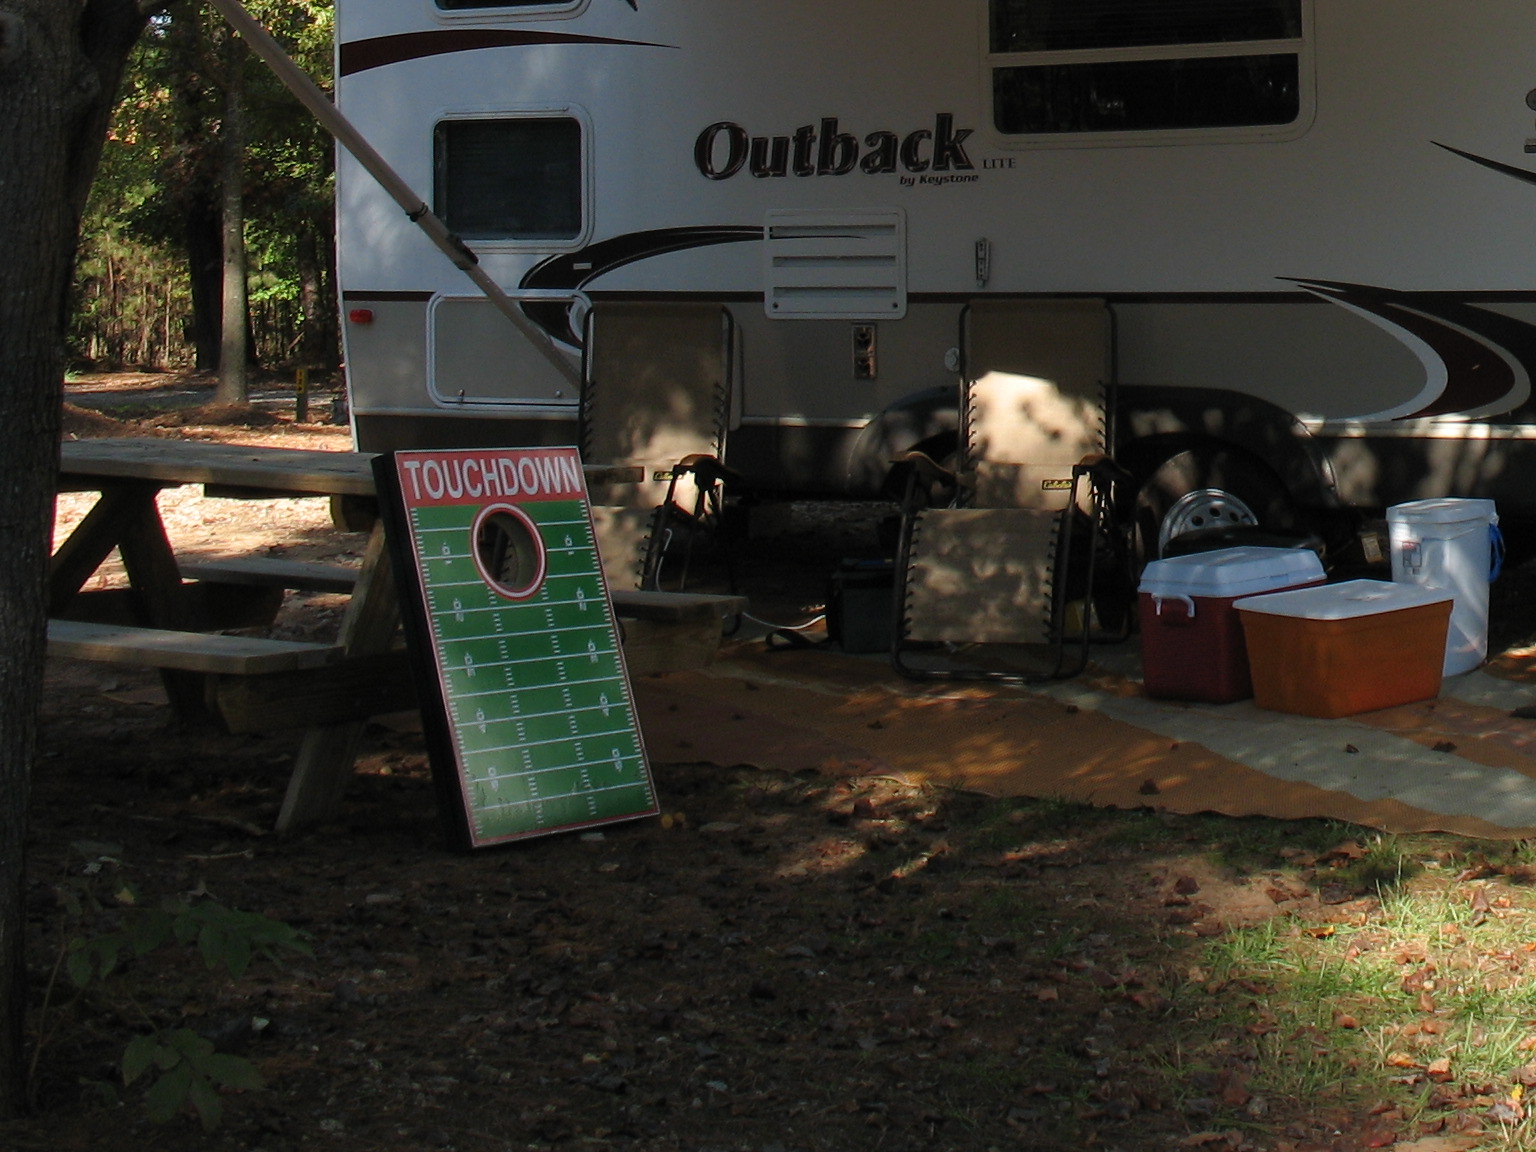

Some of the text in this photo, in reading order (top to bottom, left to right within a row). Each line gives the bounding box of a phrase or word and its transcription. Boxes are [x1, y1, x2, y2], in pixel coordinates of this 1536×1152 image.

[694, 113, 1016, 180] Outback LITE
[900, 174, 979, 187] by Keystone
[403, 456, 582, 500] TOUCHDOWN
